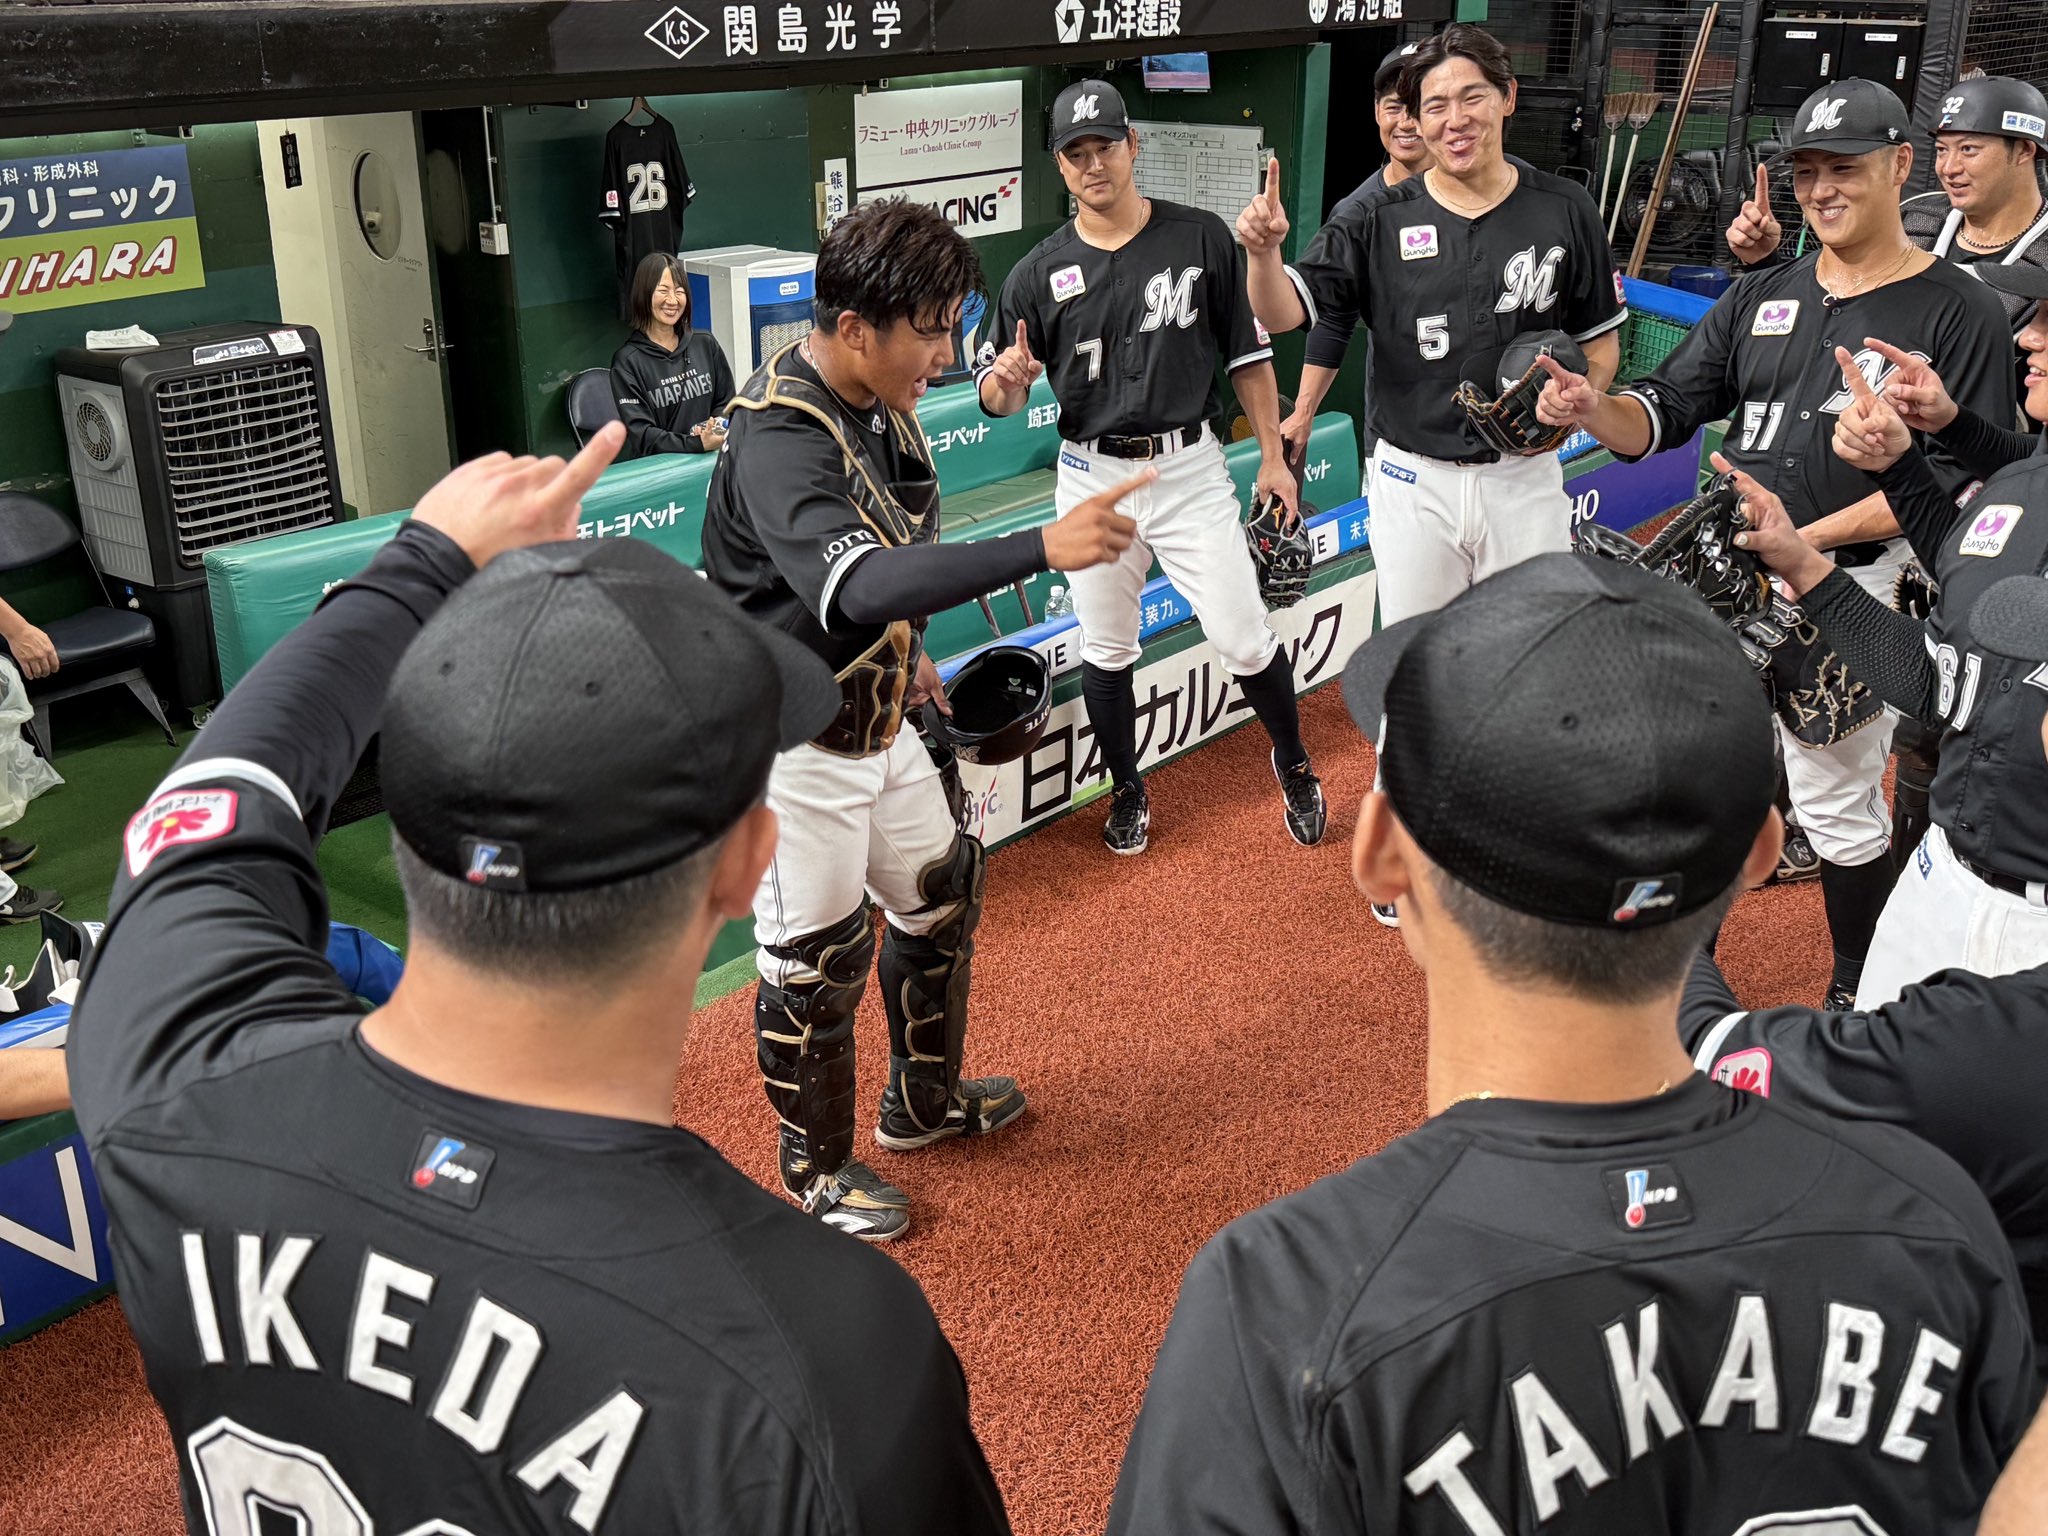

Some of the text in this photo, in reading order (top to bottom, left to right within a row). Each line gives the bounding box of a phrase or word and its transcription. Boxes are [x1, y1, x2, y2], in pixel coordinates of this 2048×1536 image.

[723, 0, 902, 57] 関島光学
[1090, 0, 1182, 41] 五洋建設
[1941, 96, 1965, 114] 32
[858, 108, 1020, 145] ラミュー・中央クリニックグループ
[0, 159, 100, 186] 科・形成外科
[626, 160, 669, 214] 26
[1403, 246, 1437, 258] GungHo
[1055, 284, 1085, 300] GungHo
[1416, 314, 1450, 361] 5
[1754, 322, 1791, 333] GungHo
[1075, 338, 1103, 382] 7
[647, 371, 713, 409] MARINES
[1740, 402, 1785, 450] 51
[822, 529, 877, 564] LOTTE
[1962, 537, 2000, 552] GungHo
[1936, 643, 1982, 731] 61
[178, 1232, 647, 1533] IKEDA
[1405, 1296, 1962, 1536] TAKABE
